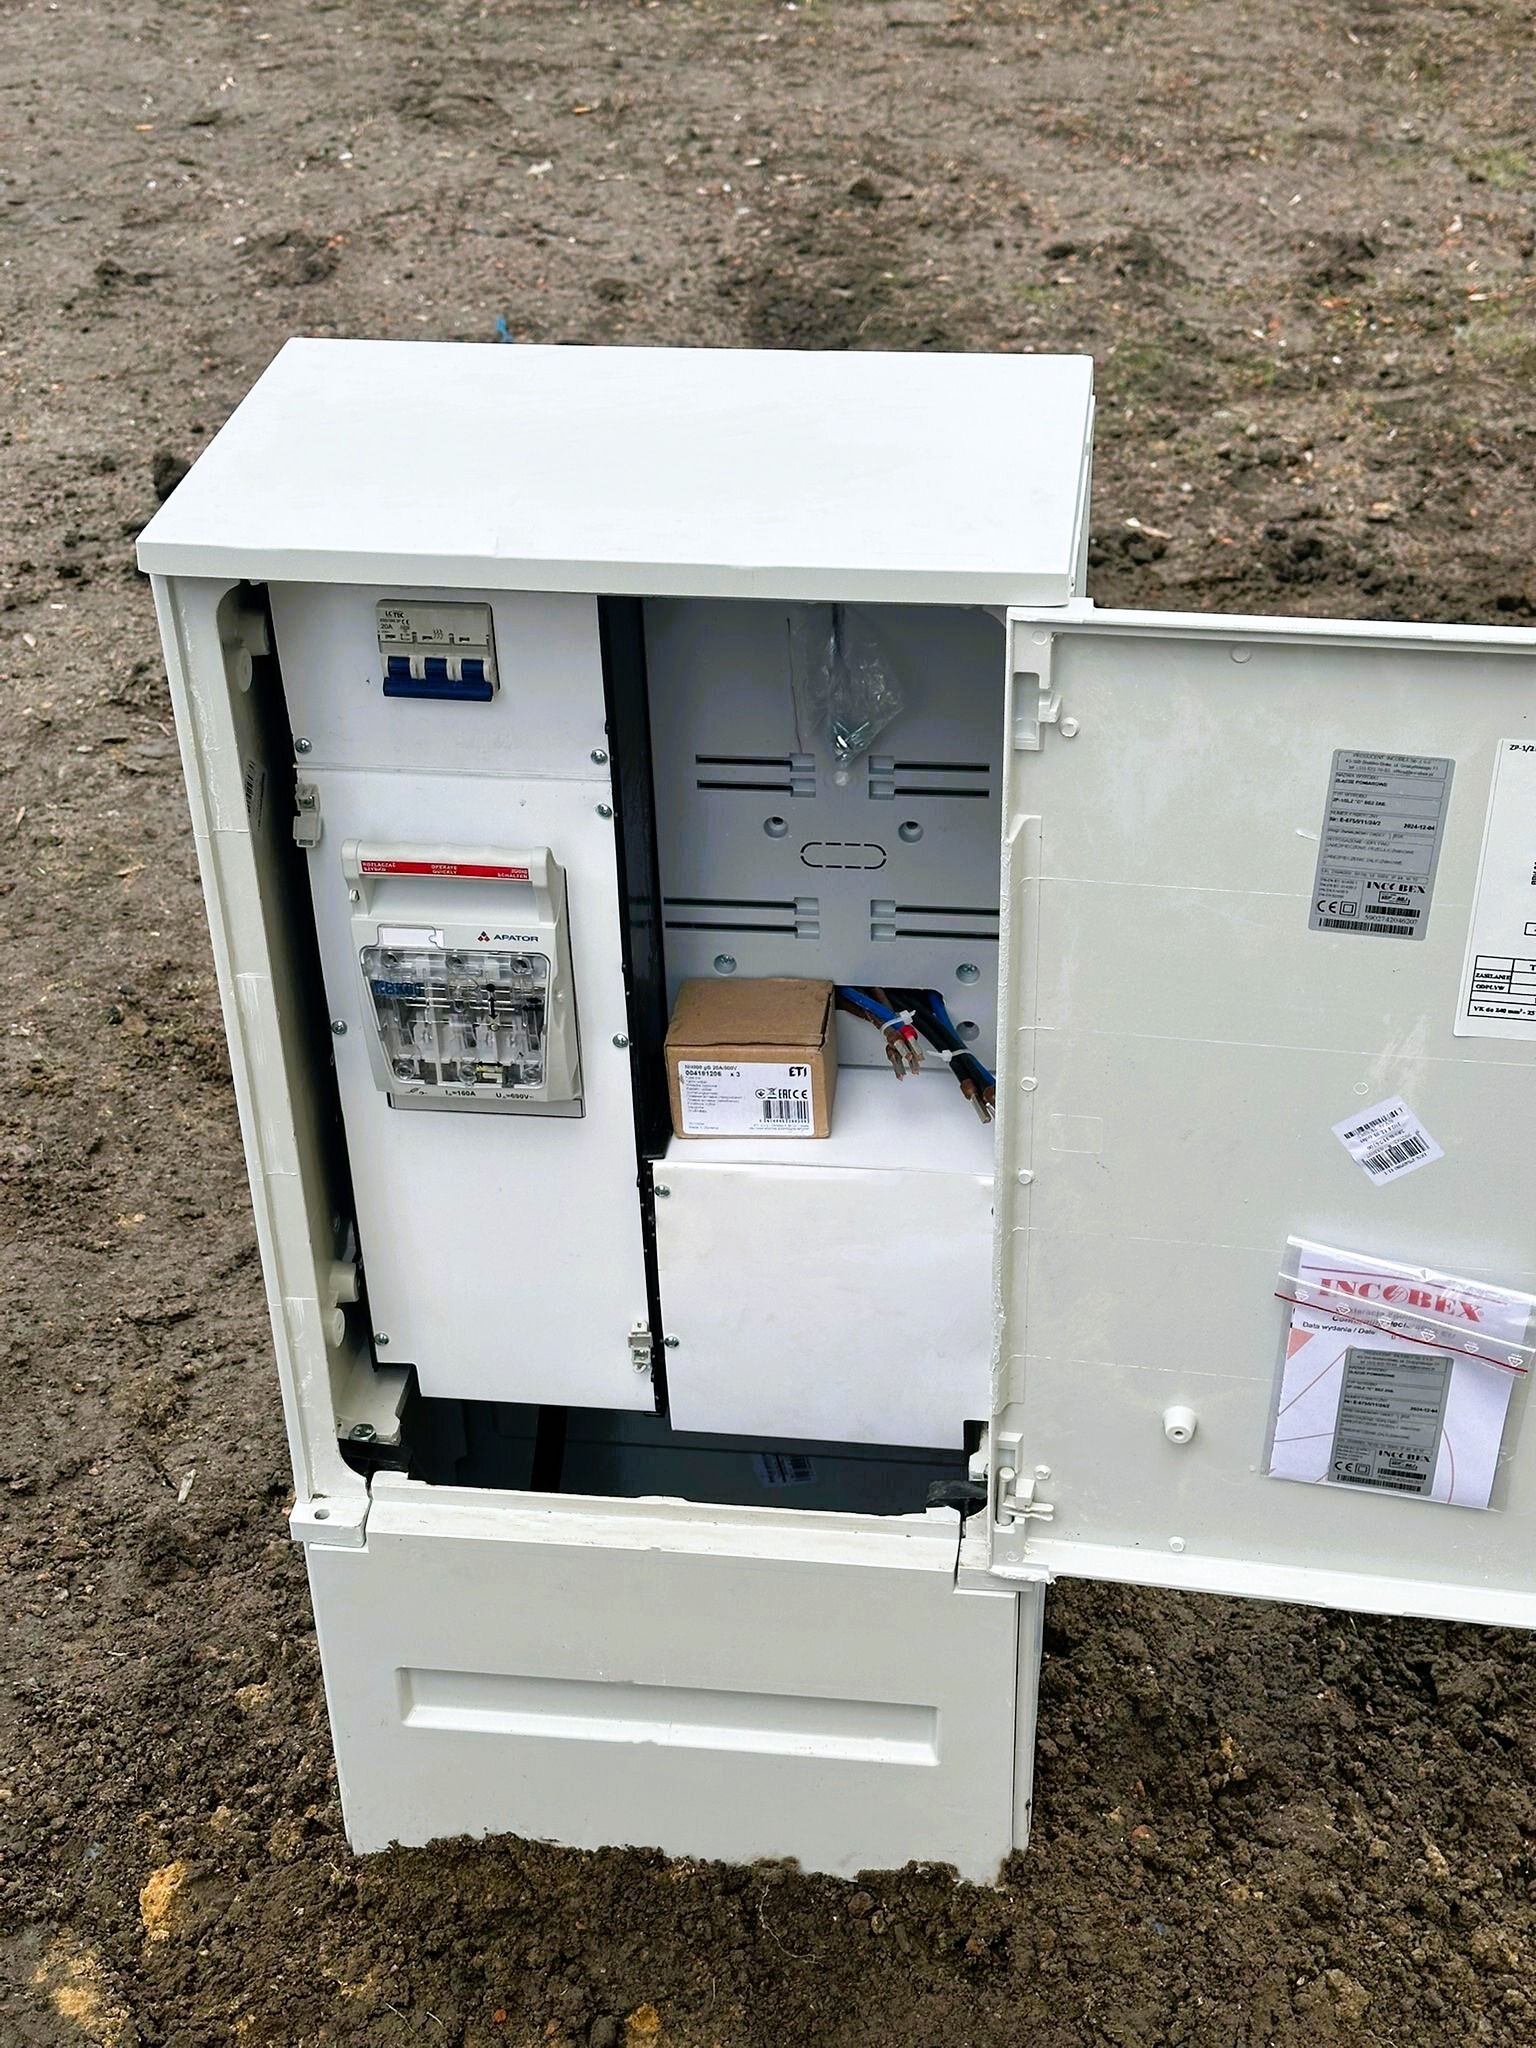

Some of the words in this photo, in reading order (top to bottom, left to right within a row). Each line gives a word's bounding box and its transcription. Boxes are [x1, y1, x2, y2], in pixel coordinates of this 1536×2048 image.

[493, 934, 539, 942] APATOR
[789, 1066, 808, 1077] ETI
[1320, 1278, 1484, 1322] INCOBEX
[1302, 1321, 1321, 1330] Data
[1321, 1324, 1351, 1333] wydania
